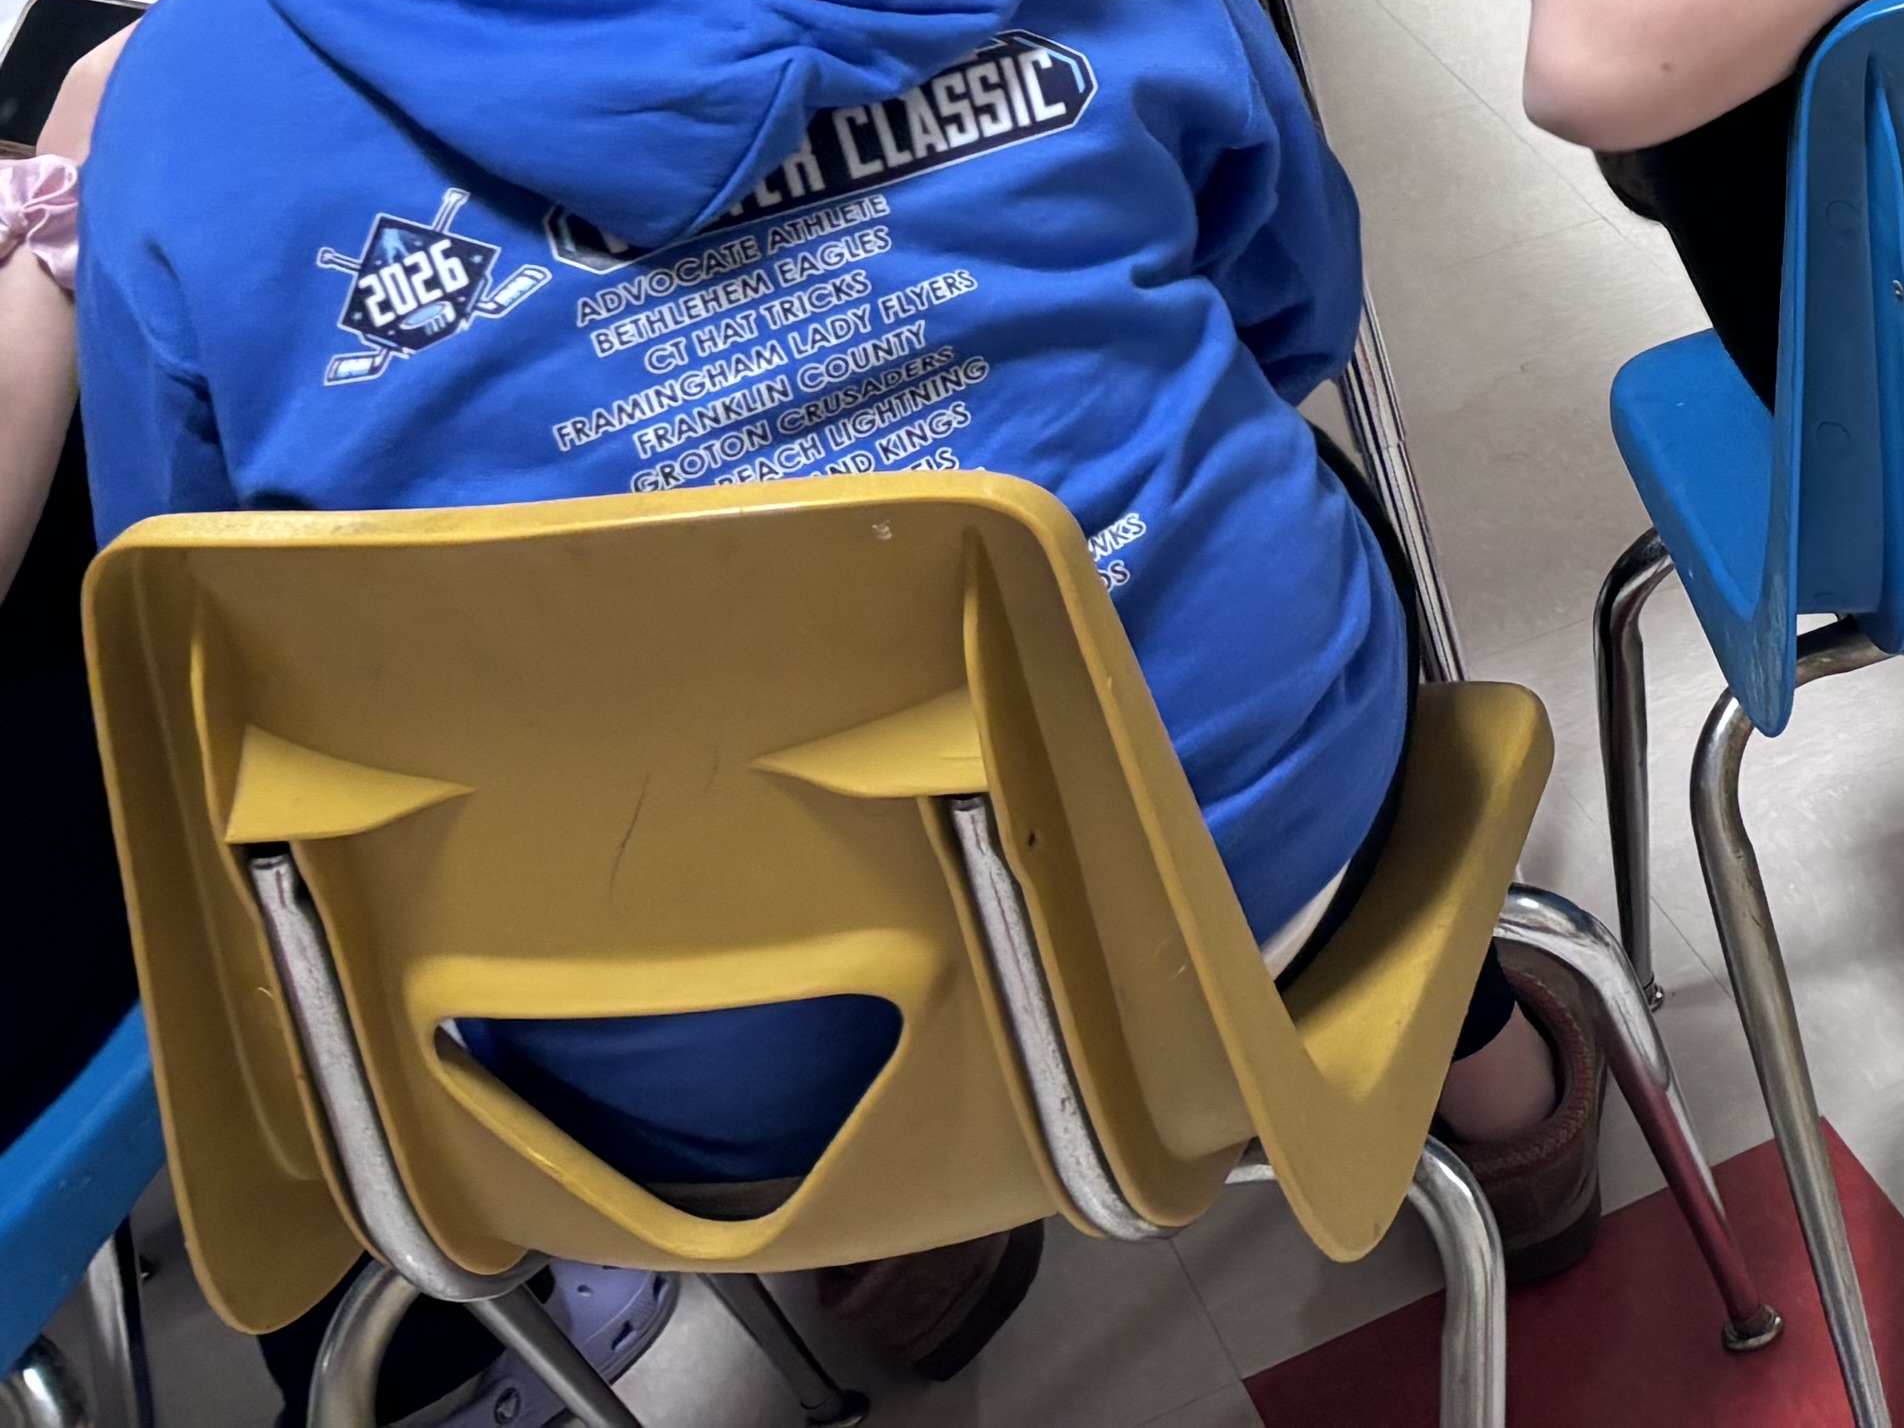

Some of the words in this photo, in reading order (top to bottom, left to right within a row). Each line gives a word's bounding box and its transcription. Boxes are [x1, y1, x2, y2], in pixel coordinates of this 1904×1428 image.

[832, 47, 1069, 181] CLASSIC
[357, 238, 471, 328] 2026
[576, 235, 762, 328] ADVOCATE
[767, 193, 892, 256] ATHLETE
[590, 269, 775, 359] BETHLEHEM
[775, 225, 893, 288] EAGLES
[645, 337, 688, 376] CT
[695, 310, 760, 359] HAT
[760, 269, 873, 331] TRICKS
[551, 344, 788, 453] FRAMINGHAM
[792, 306, 871, 358] LADY
[875, 266, 979, 327] FLYERS
[629, 419, 773, 494] GROTON
[777, 344, 956, 437] CRUSADERS
[632, 375, 795, 460] FRANKLIN
[796, 319, 928, 392] COUNTY
[828, 355, 990, 452] LIGHTNING
[880, 401, 972, 465] KINGS
